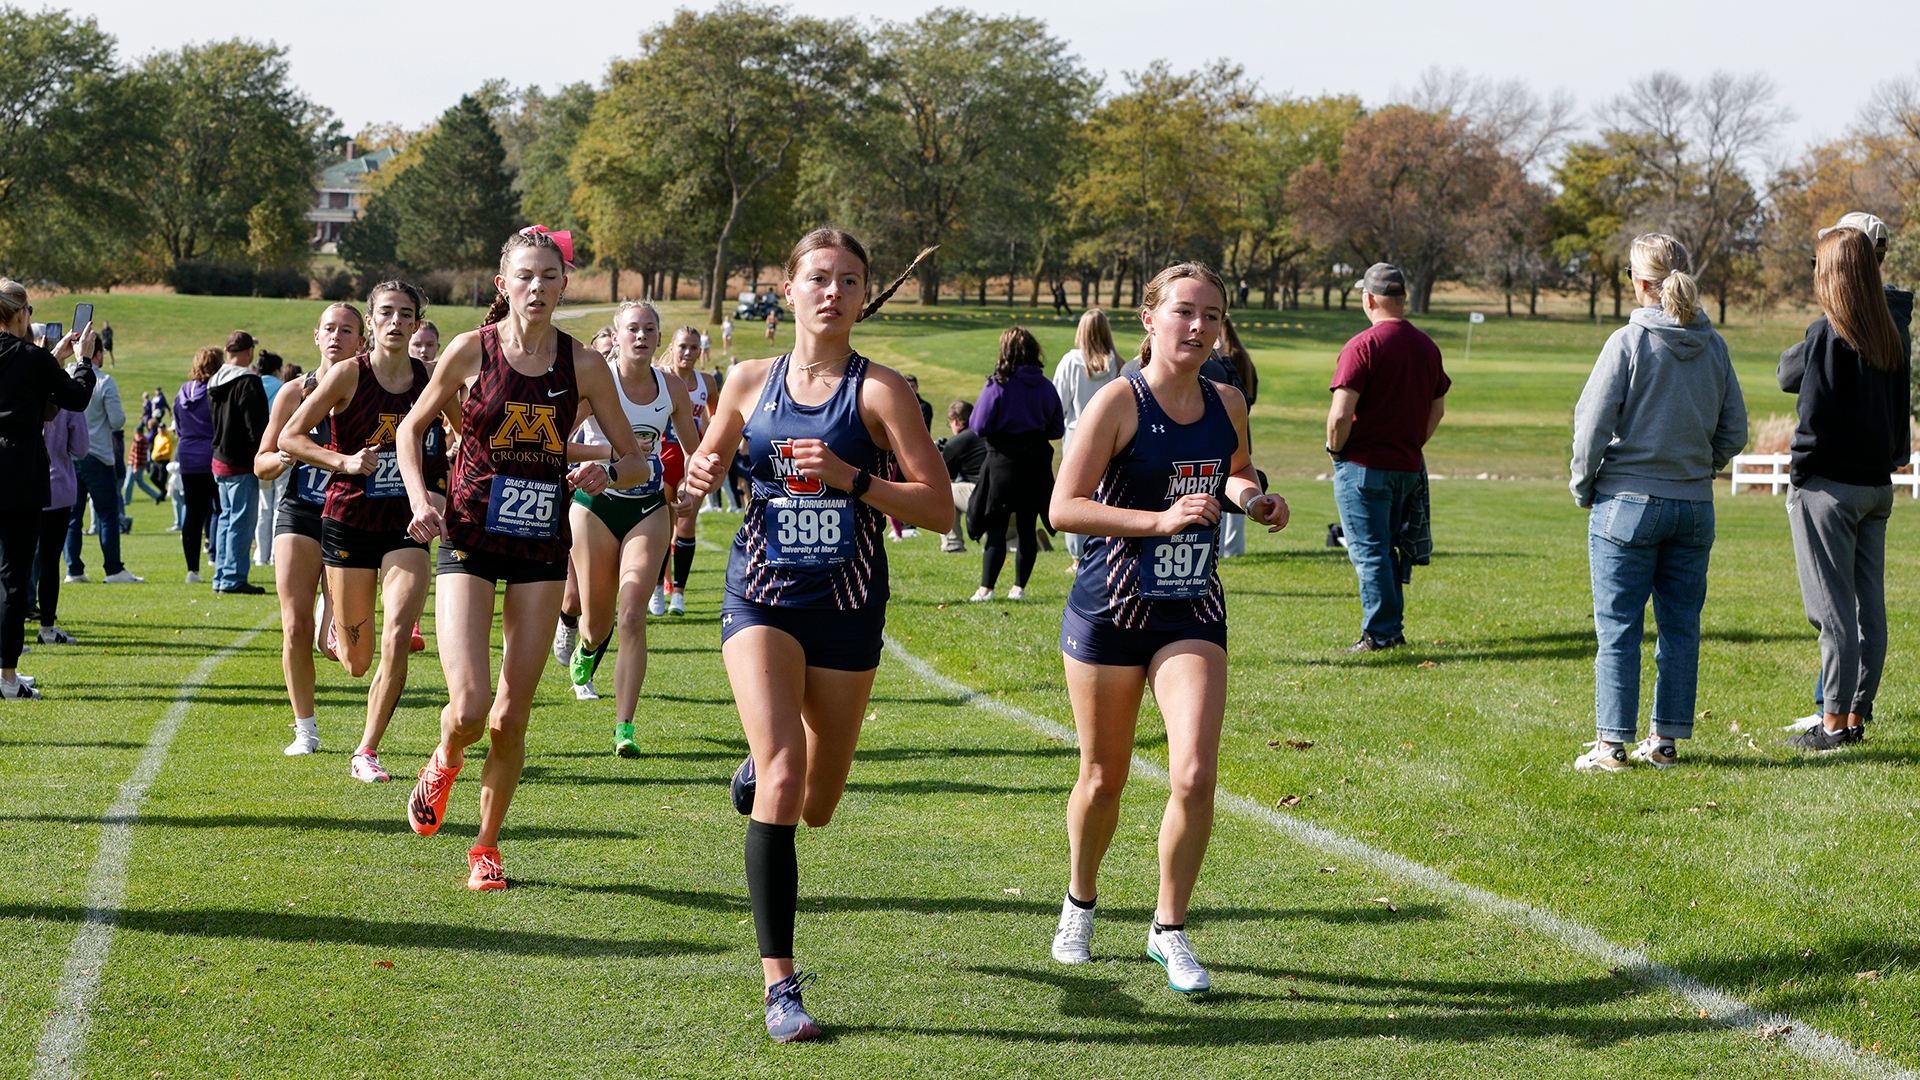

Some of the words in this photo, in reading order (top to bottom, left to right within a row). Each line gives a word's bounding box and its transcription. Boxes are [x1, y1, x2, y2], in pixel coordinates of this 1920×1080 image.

[489, 401, 565, 455] M
[492, 450, 562, 467] CROOKSTON
[307, 467, 332, 491] 17
[374, 458, 401, 483] 22
[504, 478, 527, 489] GRACE
[526, 481, 558, 492] ALWARDT
[1169, 475, 1220, 496] MARY
[499, 487, 556, 521] 225
[798, 499, 847, 509] BORNEMANN
[525, 520, 551, 528] Crookston
[777, 509, 841, 545] 398
[1170, 534, 1184, 543] BRE
[1185, 533, 1199, 543] AXT
[781, 545, 812, 554] University
[813, 545, 821, 553] of
[820, 545, 839, 554] Mary
[1153, 543, 1211, 578] 397
[1156, 578, 1186, 586] University
[1186, 578, 1193, 586] of
[1192, 578, 1207, 586] Mary
